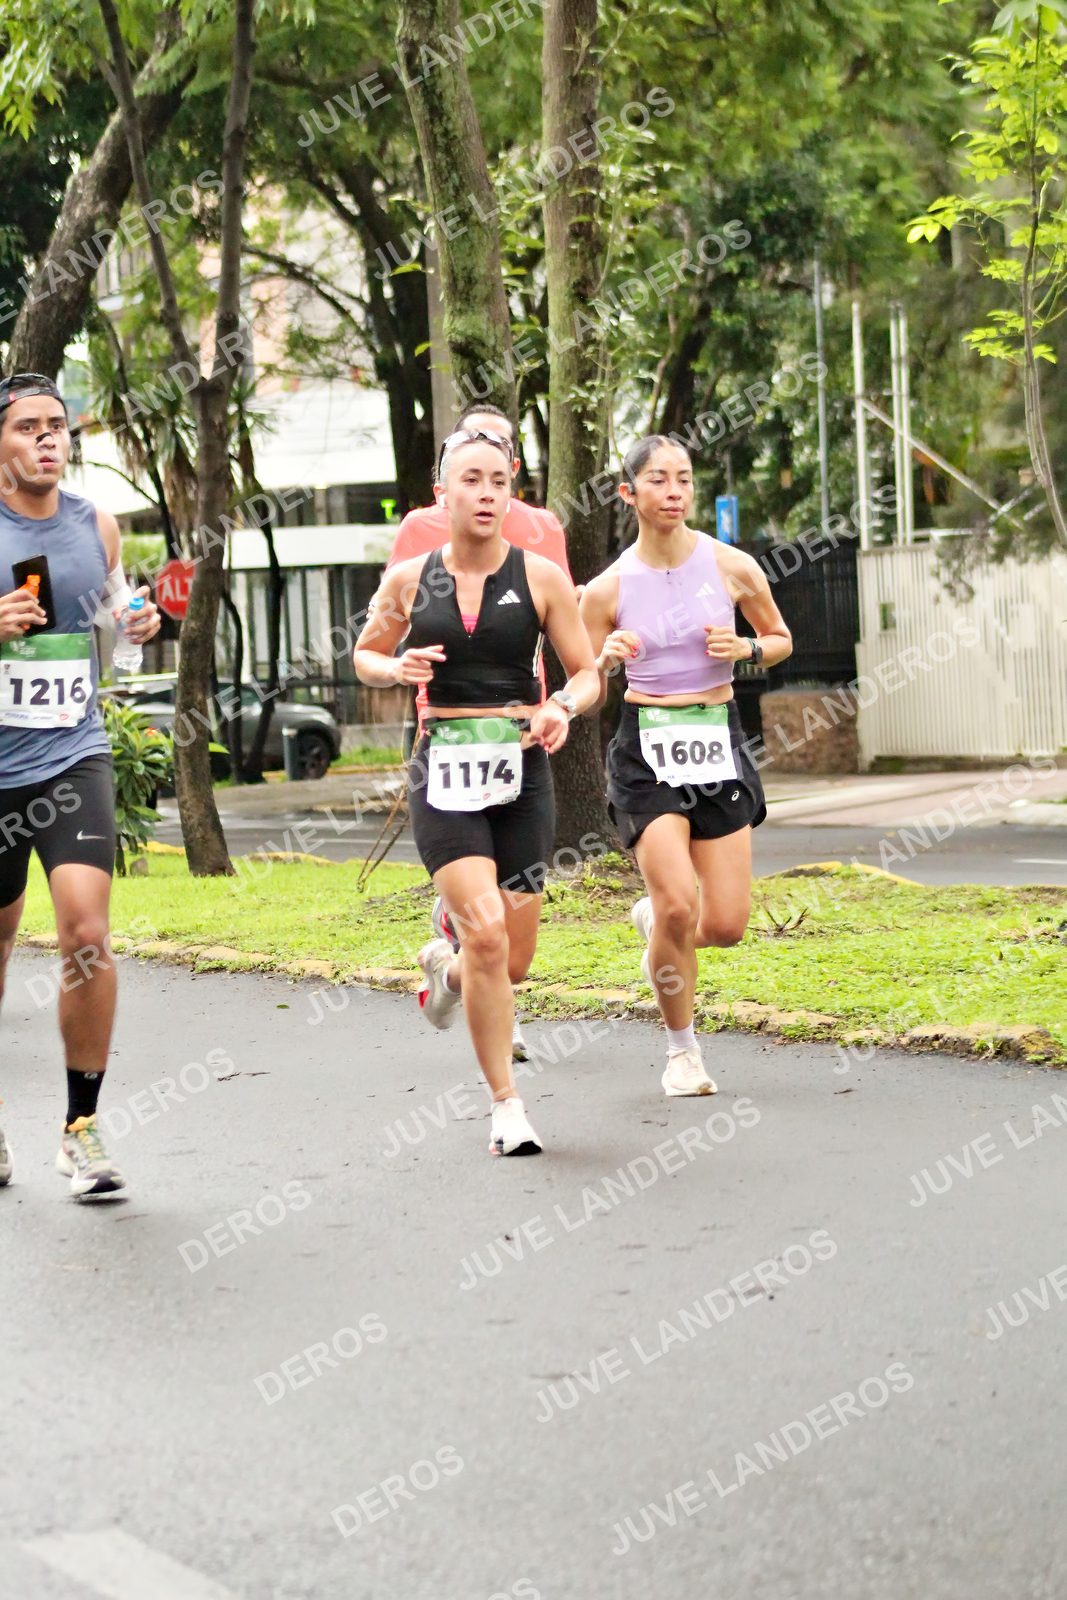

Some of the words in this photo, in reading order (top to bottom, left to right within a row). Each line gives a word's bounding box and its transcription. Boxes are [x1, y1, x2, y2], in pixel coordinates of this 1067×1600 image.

[161, 577, 194, 602] ALT
[10, 676, 86, 706] 1216
[651, 740, 726, 768] 1608
